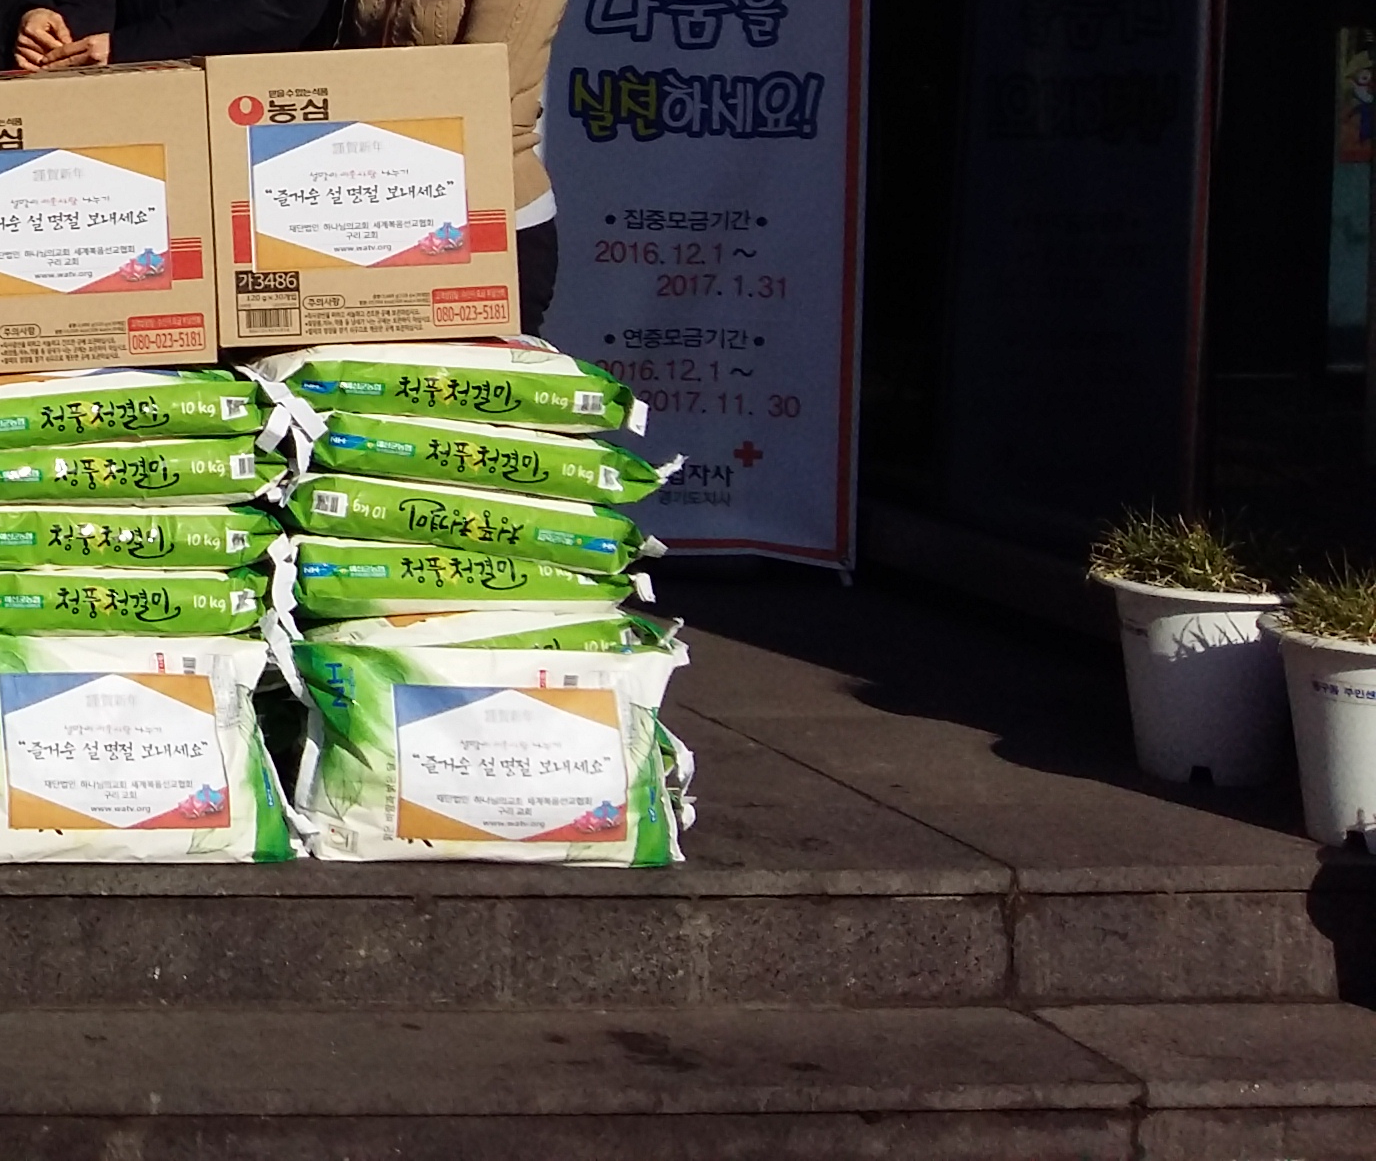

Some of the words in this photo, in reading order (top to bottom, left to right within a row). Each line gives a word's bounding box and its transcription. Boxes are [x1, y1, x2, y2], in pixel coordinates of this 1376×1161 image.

[268, 98, 329, 123] 농심
[569, 64, 825, 143] 실천하세요!
[326, 186, 343, 205] 설
[347, 184, 380, 204] 명절
[624, 209, 751, 231] 집중모금기간
[238, 272, 297, 290] 가3486
[436, 304, 507, 322] 080-023-5181
[132, 332, 202, 350] 080-023-5181
[623, 329, 747, 349] 연중모금기간
[180, 401, 197, 415] 10
[198, 401, 216, 417] kg
[534, 391, 549, 404] 10
[550, 392, 569, 409] kg
[190, 461, 206, 475] 10
[207, 460, 226, 476] kg
[562, 465, 576, 477] 10
[577, 467, 594, 483] kg
[187, 533, 202, 547] 10
[203, 533, 220, 550] kg
[193, 595, 208, 609] 10
[210, 595, 226, 612] kg
[325, 663, 347, 708] NH
